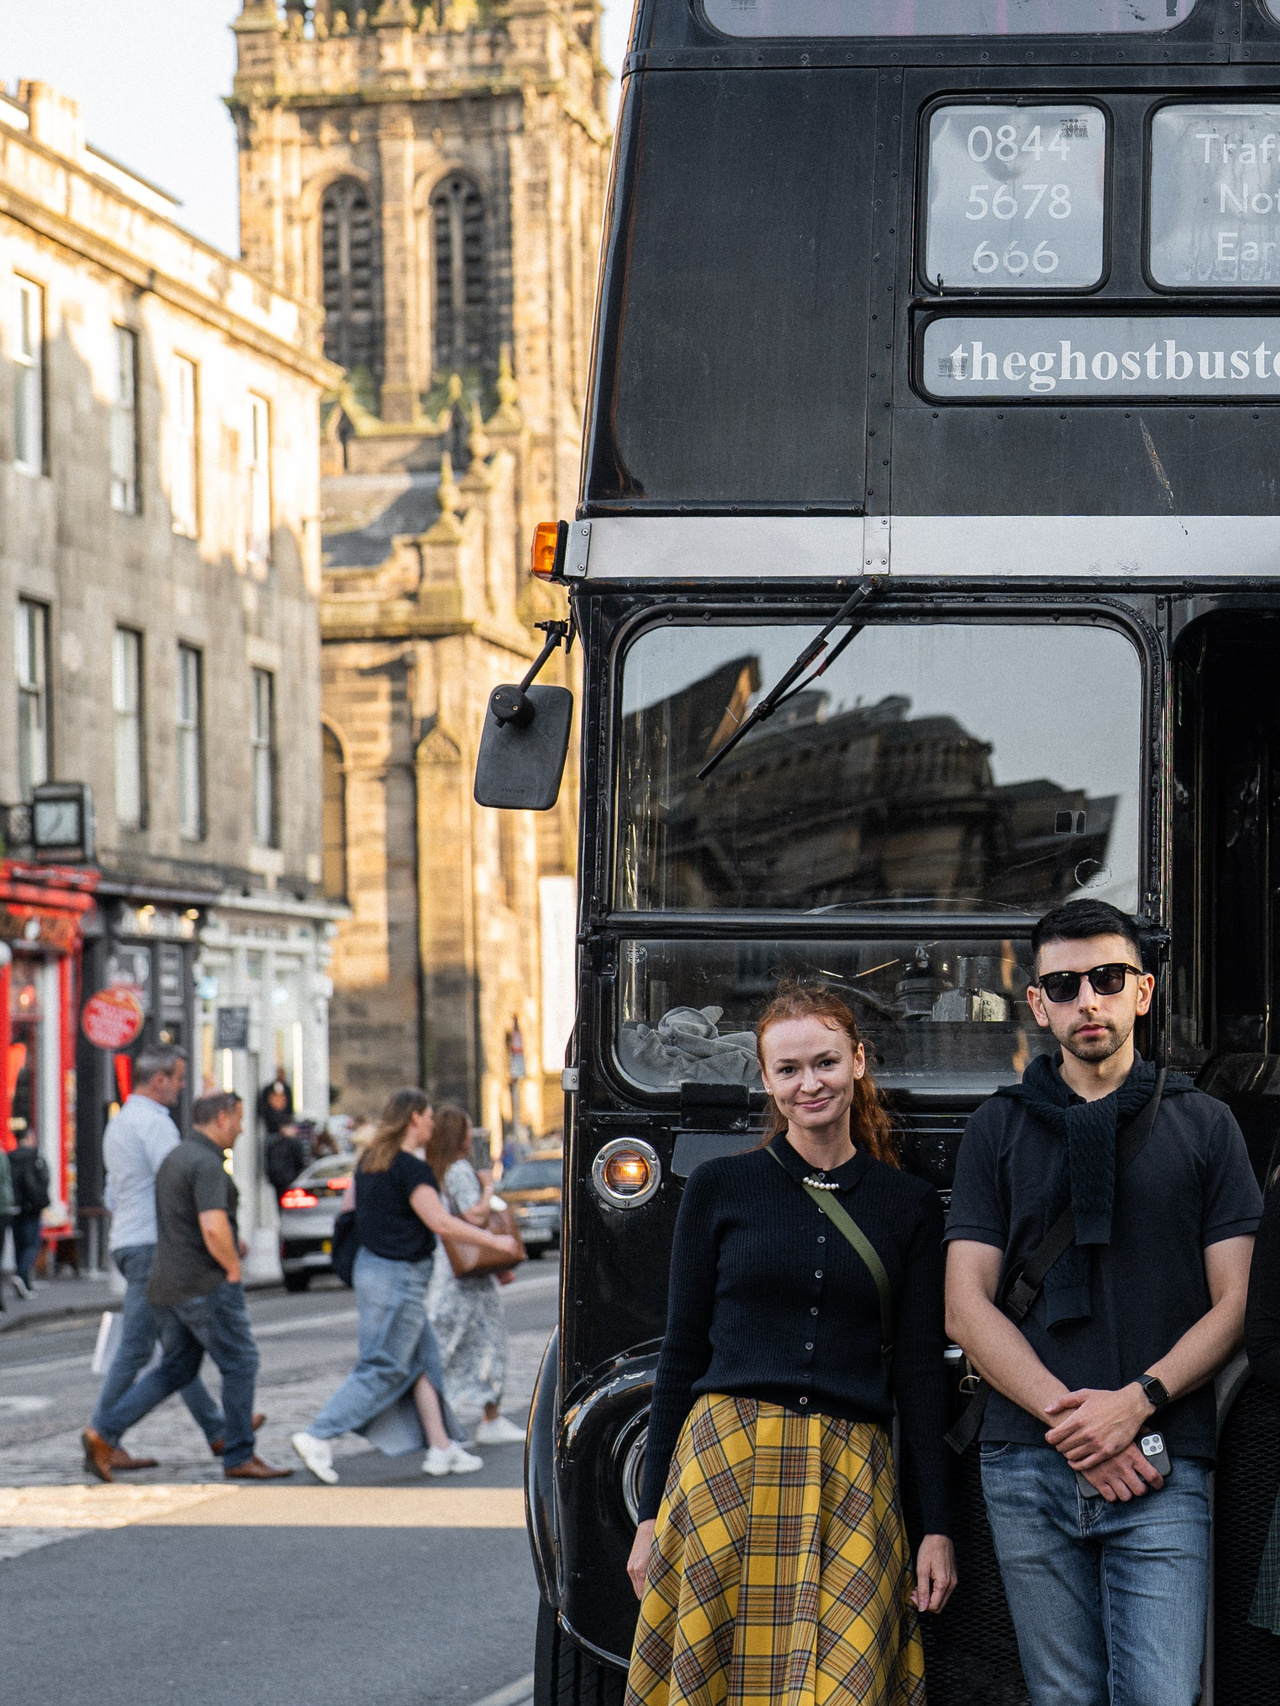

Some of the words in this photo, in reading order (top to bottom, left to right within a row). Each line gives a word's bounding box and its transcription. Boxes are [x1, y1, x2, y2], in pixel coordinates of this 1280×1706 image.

[967, 124, 1071, 162] 0844
[965, 183, 1072, 221] 5678
[972, 240, 1059, 275] 666
